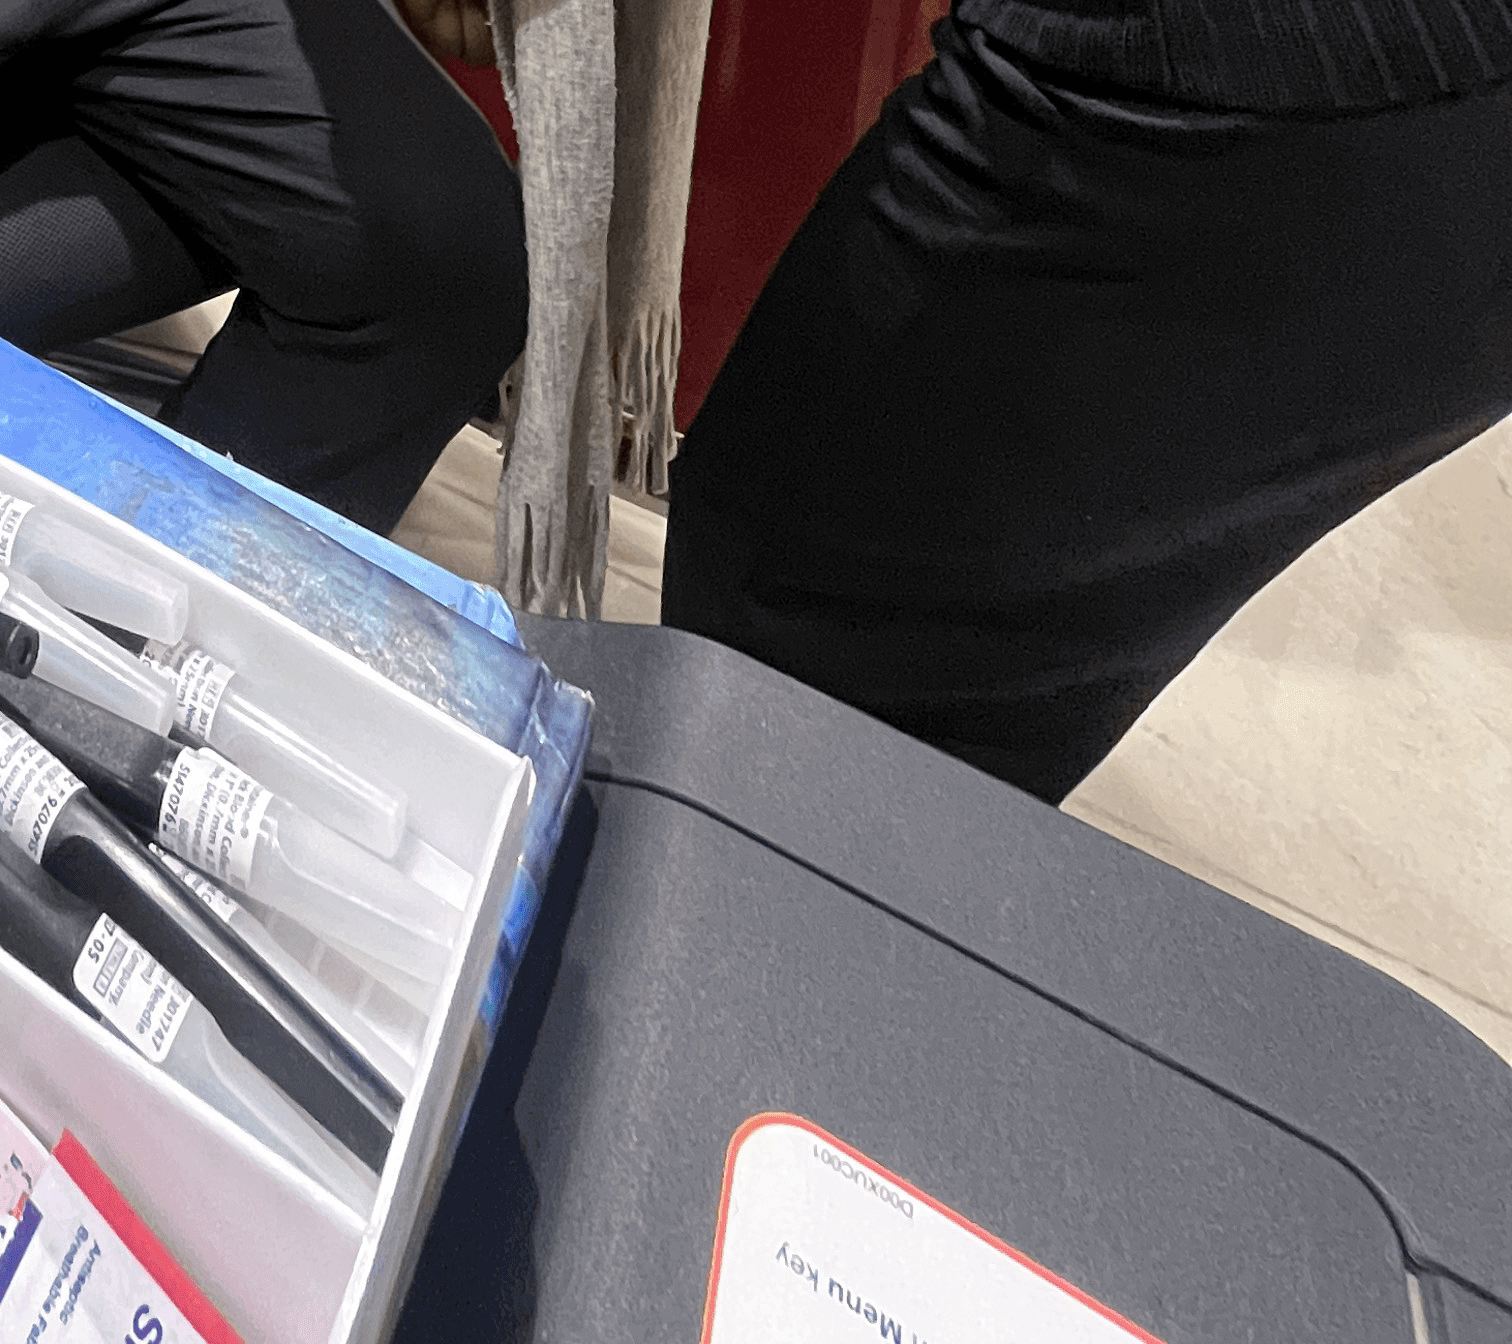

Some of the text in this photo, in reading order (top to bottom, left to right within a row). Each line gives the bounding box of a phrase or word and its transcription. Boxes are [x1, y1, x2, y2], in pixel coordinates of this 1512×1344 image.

[134, 986, 165, 1035] Needle
[39, 1224, 91, 1315] Breathable
[55, 1238, 105, 1326] Antiseptic
[774, 1241, 907, 1343] Menu key
